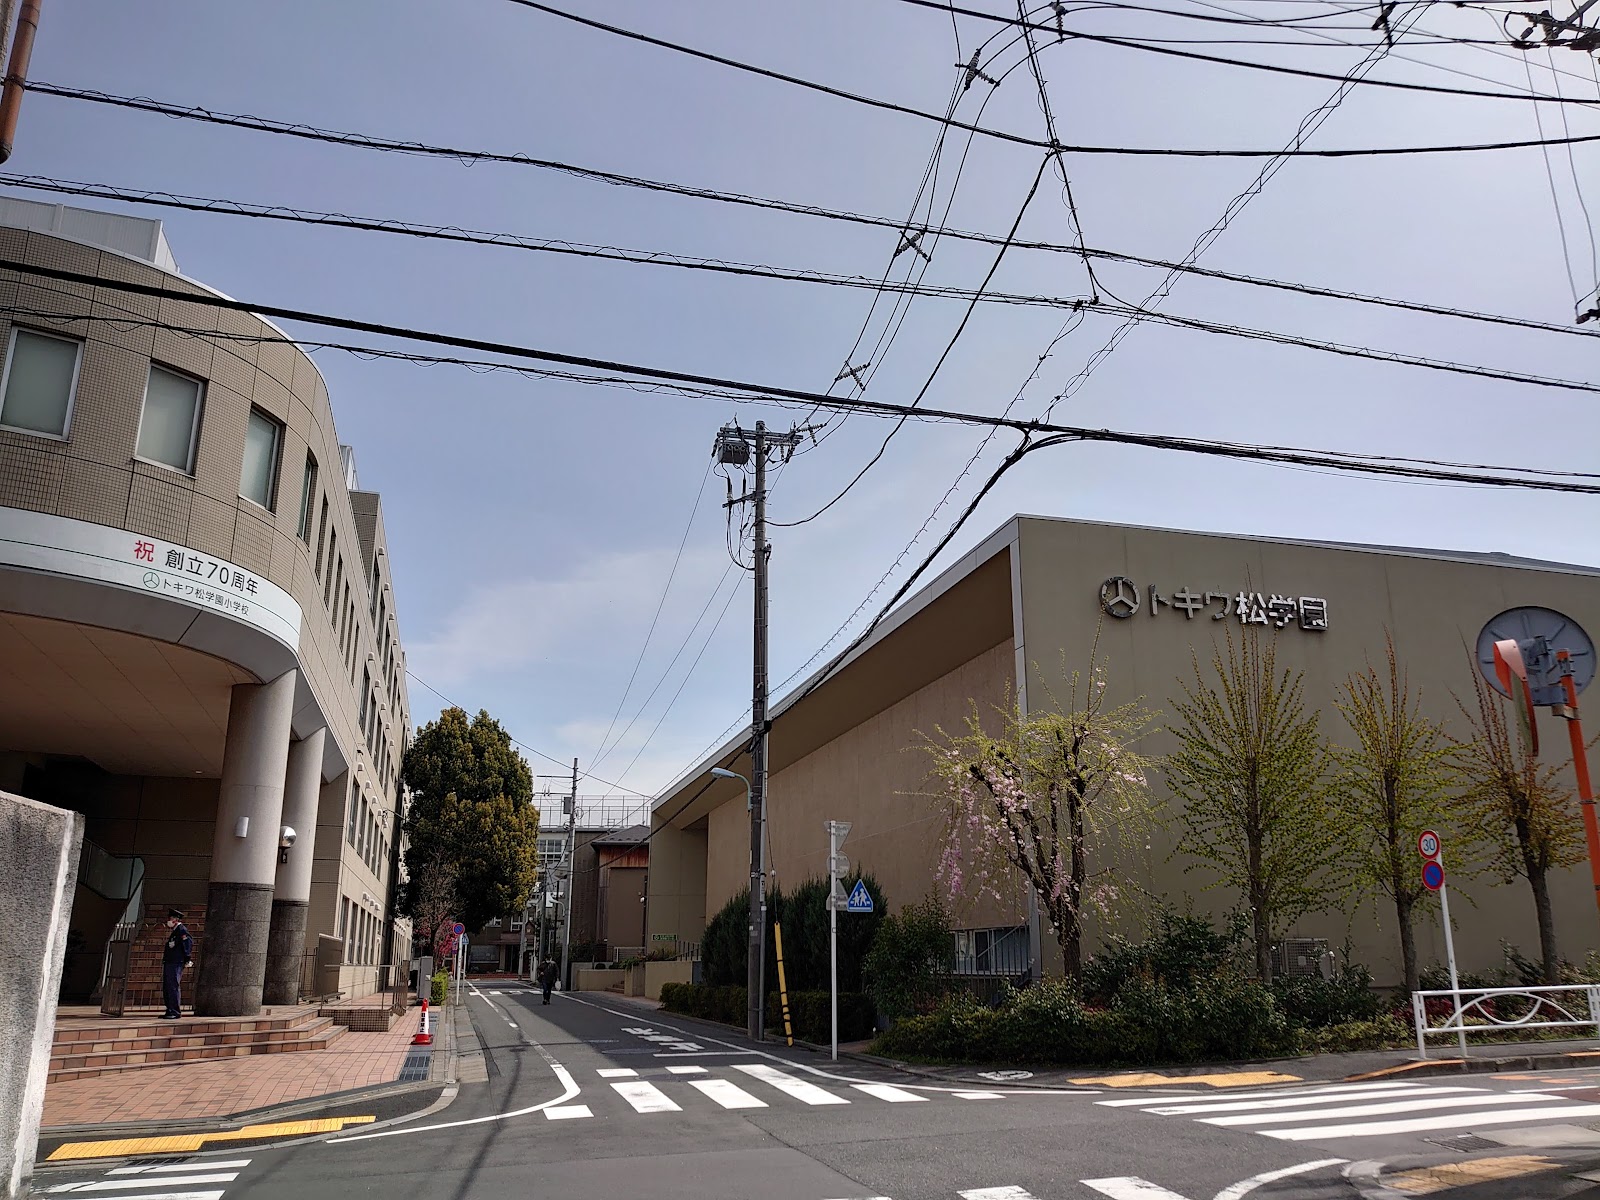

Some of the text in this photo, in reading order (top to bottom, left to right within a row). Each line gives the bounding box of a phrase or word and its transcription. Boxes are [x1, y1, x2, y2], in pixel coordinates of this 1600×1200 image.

[134, 540, 259, 597] 祝 創立70周年
[162, 578, 250, 617] トキワ松学園小学校
[1149, 583, 1329, 632] トキワ松学園
[1422, 838, 1436, 851] 30
